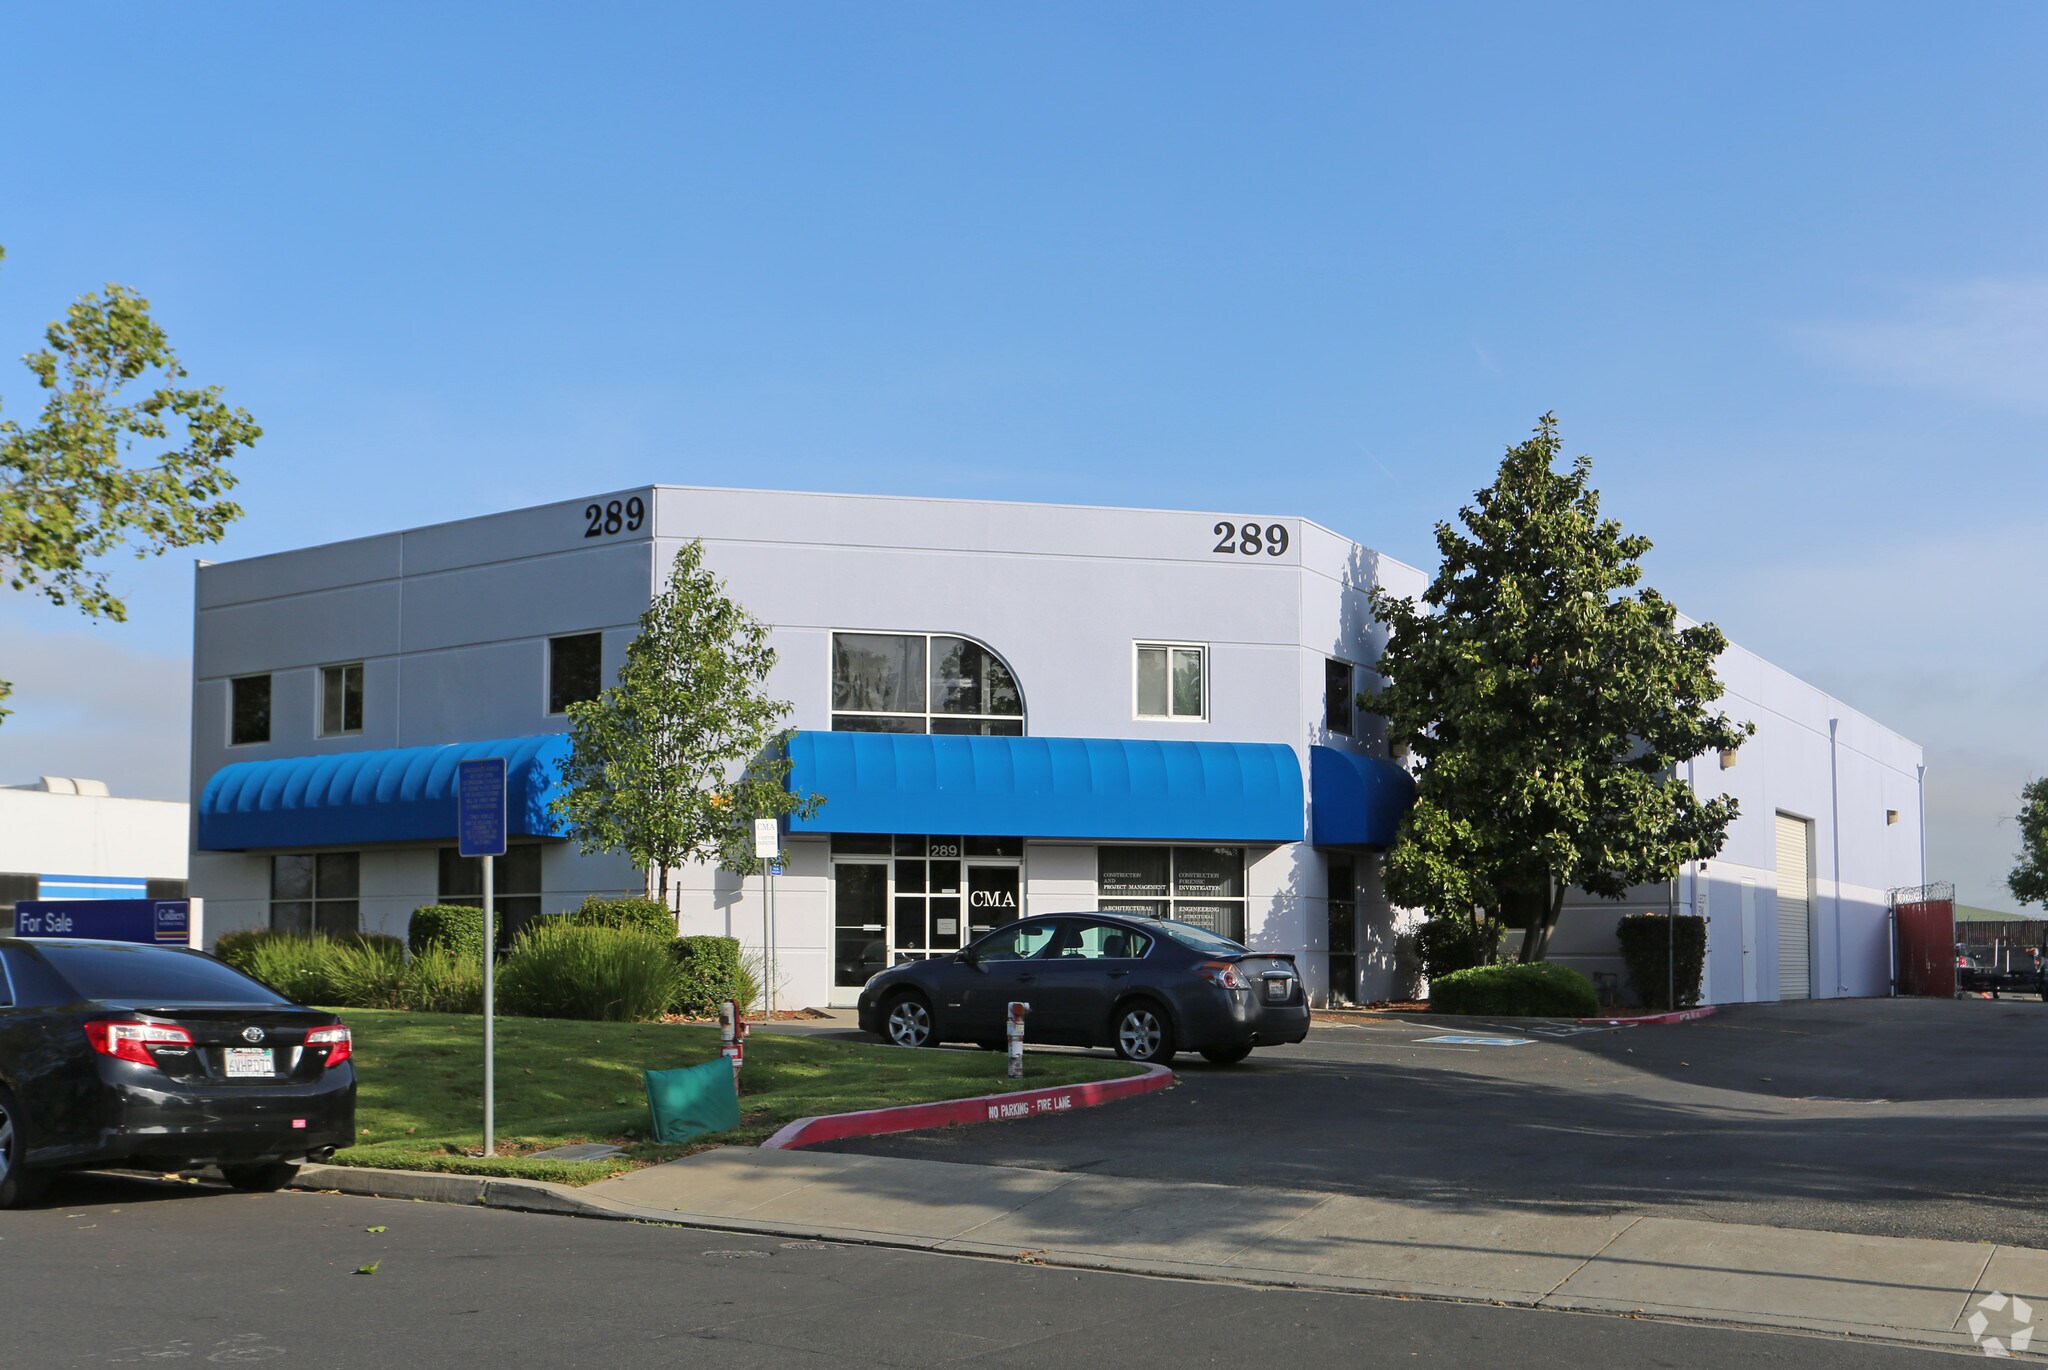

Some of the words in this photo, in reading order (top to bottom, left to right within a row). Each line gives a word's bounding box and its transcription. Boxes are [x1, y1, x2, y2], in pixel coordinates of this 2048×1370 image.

[584, 496, 645, 538] 289
[1213, 521, 1289, 557] 289
[757, 823, 775, 831] CMA
[931, 845, 957, 857] 289
[970, 891, 1016, 907] CMA
[20, 912, 42, 932] For
[46, 912, 73, 932] Sale
[158, 909, 186, 921] Colliers
[988, 1106, 999, 1119] NO
[1000, 1102, 1029, 1117] PARKING
[1036, 1098, 1052, 1112] FIRE
[1053, 1095, 1072, 1110] LANE
